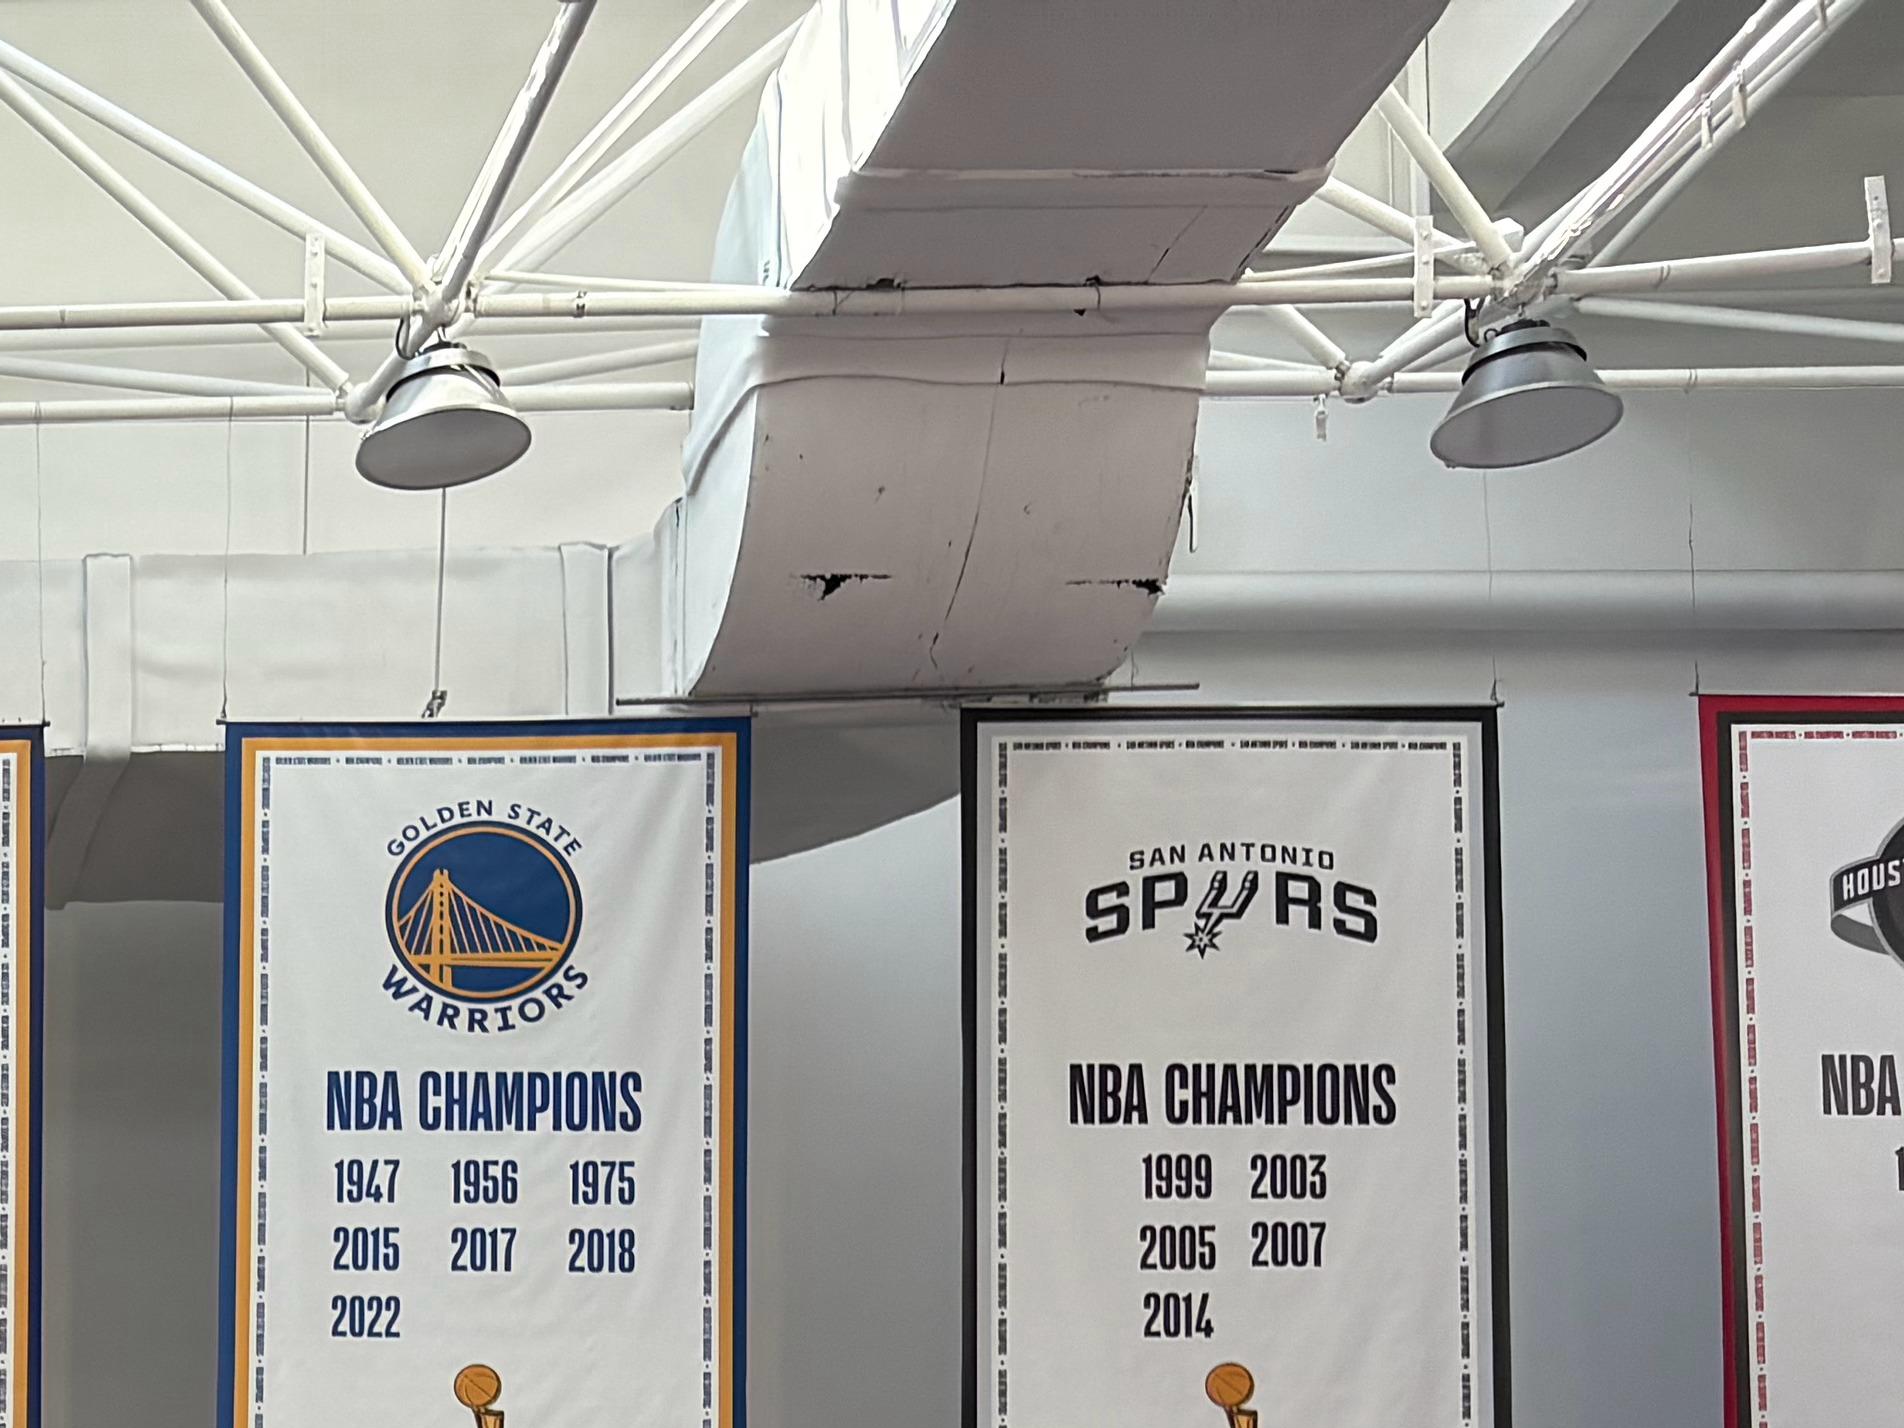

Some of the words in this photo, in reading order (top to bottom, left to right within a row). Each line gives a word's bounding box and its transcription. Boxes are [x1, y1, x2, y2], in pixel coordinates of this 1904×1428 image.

[386, 798, 495, 859] GOLDEN
[507, 802, 583, 858] STATE
[1128, 843, 1186, 870] SAN
[1197, 841, 1336, 870] ANTONIO
[1842, 858, 1904, 900] HOUS
[1083, 869, 1379, 958] SPURS
[382, 964, 589, 1035] WARRIORS
[326, 1070, 403, 1131] NBA
[418, 1070, 642, 1133] CHAMPIONS
[1069, 1062, 1149, 1125] NBA
[1165, 1062, 1397, 1126] CHAMPIONS
[1821, 1054, 1902, 1115] NBA
[334, 1158, 401, 1204] 1947
[451, 1159, 519, 1204] 1956
[569, 1160, 636, 1206] 1975
[1142, 1153, 1213, 1200] 1999
[1250, 1153, 1327, 1200] 2003
[333, 1226, 400, 1272] 2015
[450, 1227, 517, 1273] 2017
[568, 1228, 636, 1274] 2018
[1139, 1224, 1217, 1271] 2005
[1251, 1221, 1327, 1268] 2007
[331, 1294, 401, 1338] 2022
[1143, 1292, 1215, 1339] 2014
